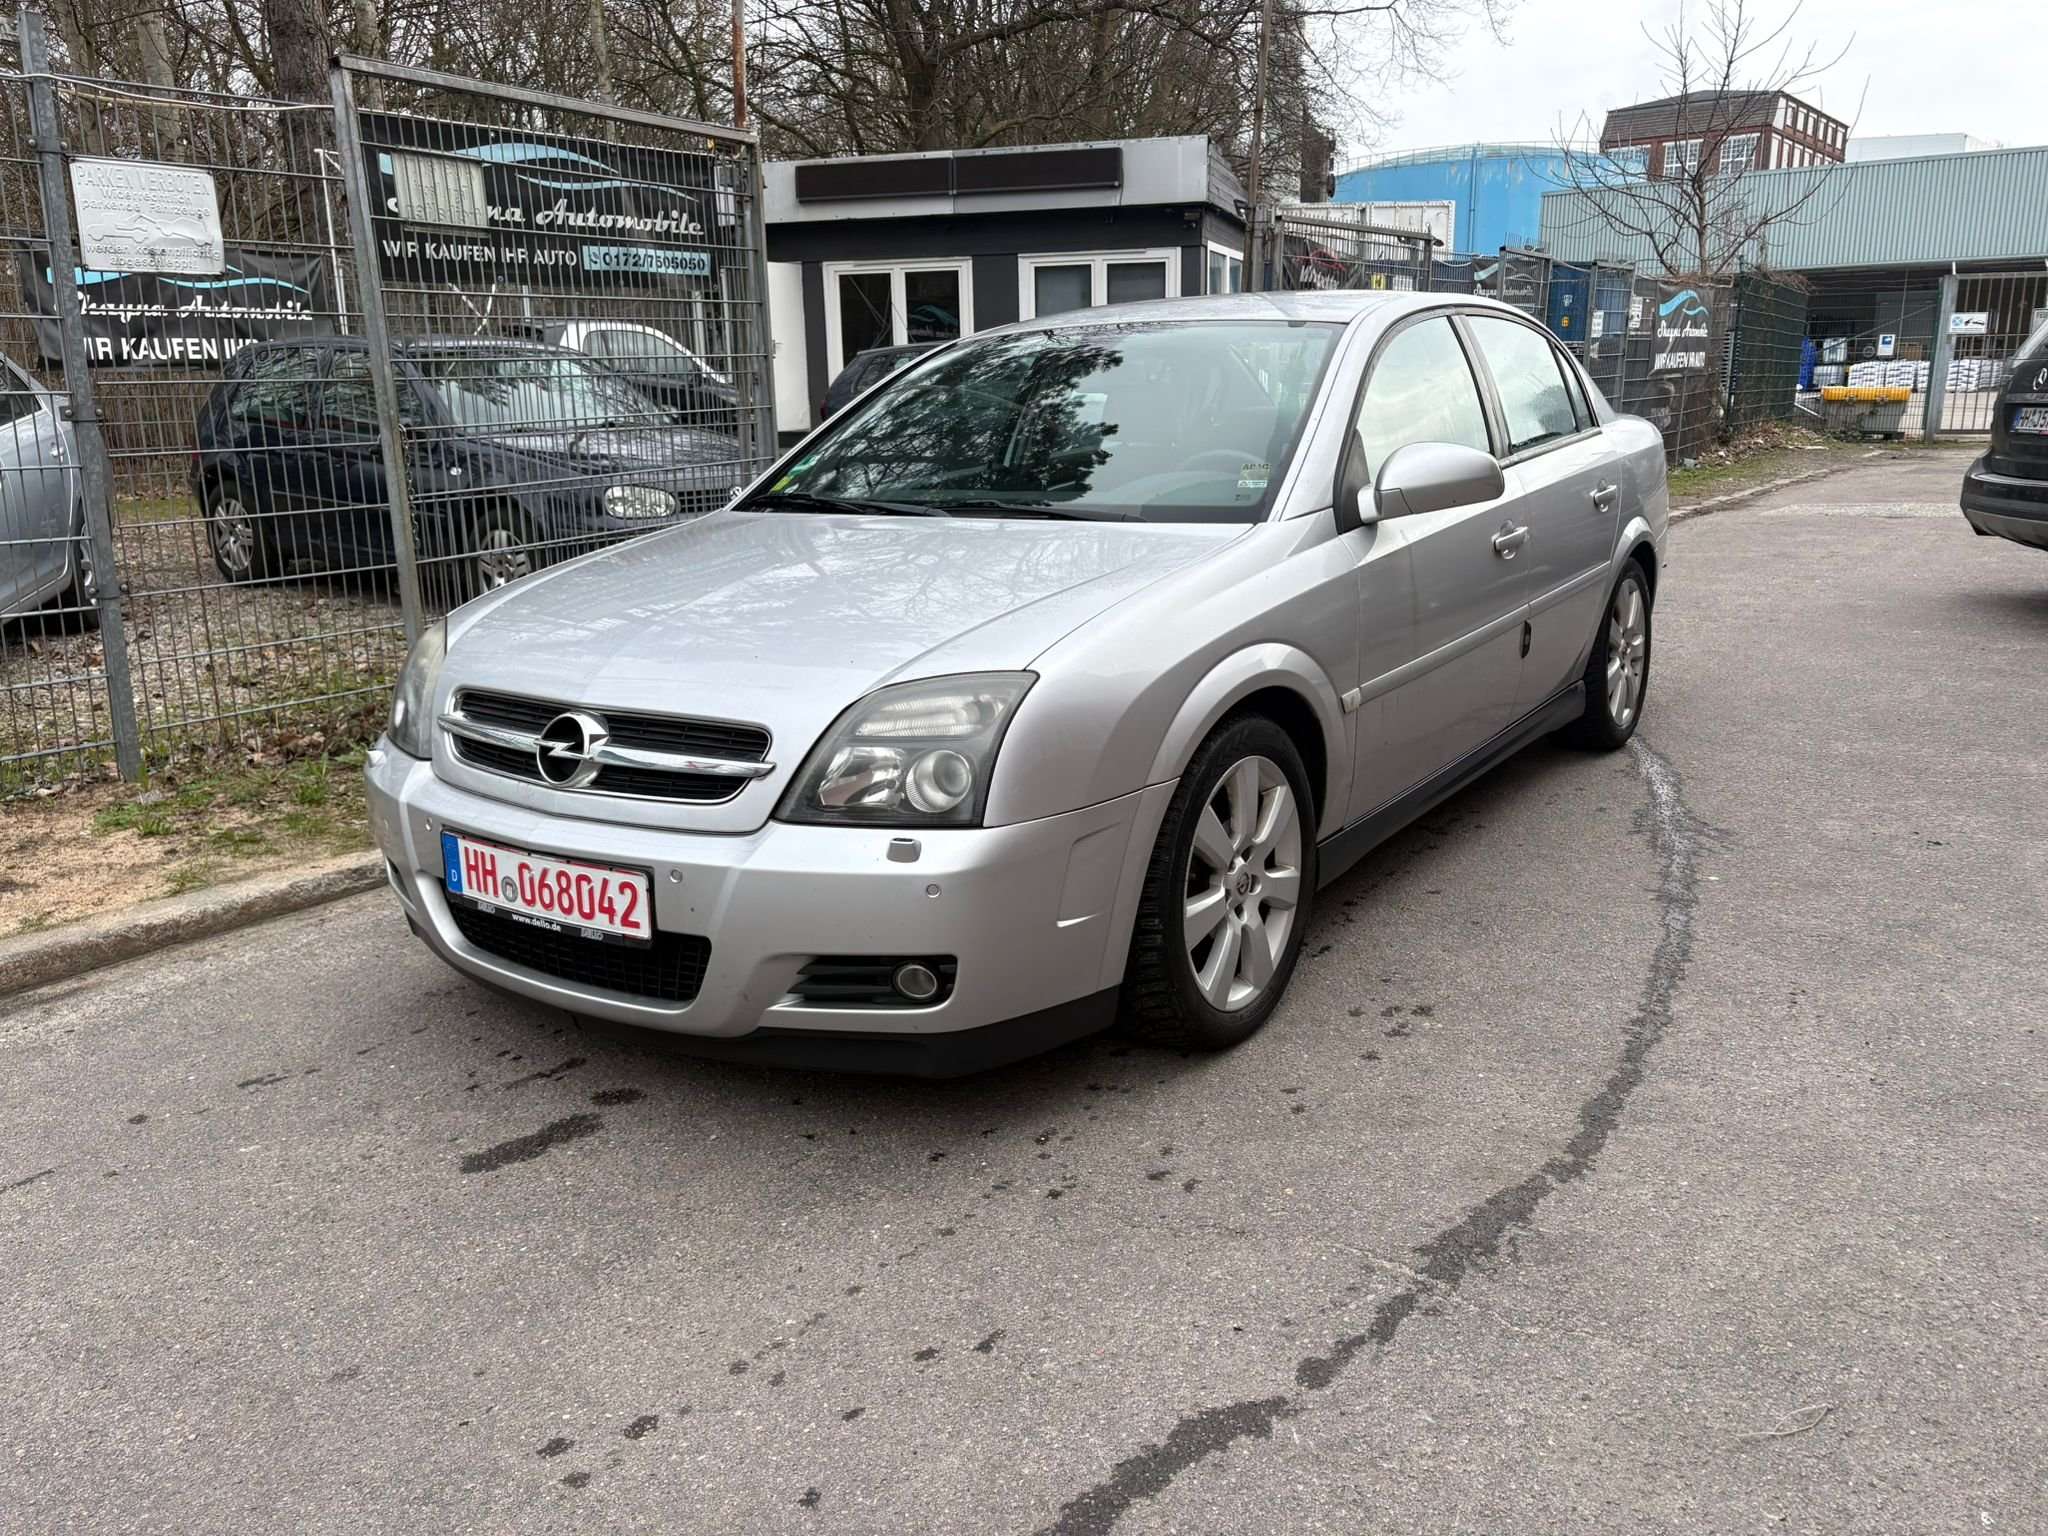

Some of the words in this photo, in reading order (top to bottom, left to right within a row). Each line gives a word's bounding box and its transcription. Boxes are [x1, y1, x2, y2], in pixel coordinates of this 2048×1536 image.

[535, 198, 705, 236] Automobile
[425, 242, 496, 262] KAUFEN
[500, 247, 529, 264] IHR
[533, 248, 577, 266] AUTO
[122, 337, 220, 361] KAUFEN
[451, 868, 458, 882] D
[464, 846, 499, 898] HH
[517, 861, 641, 930] 068042
[511, 912, 562, 933] www.dello.de
